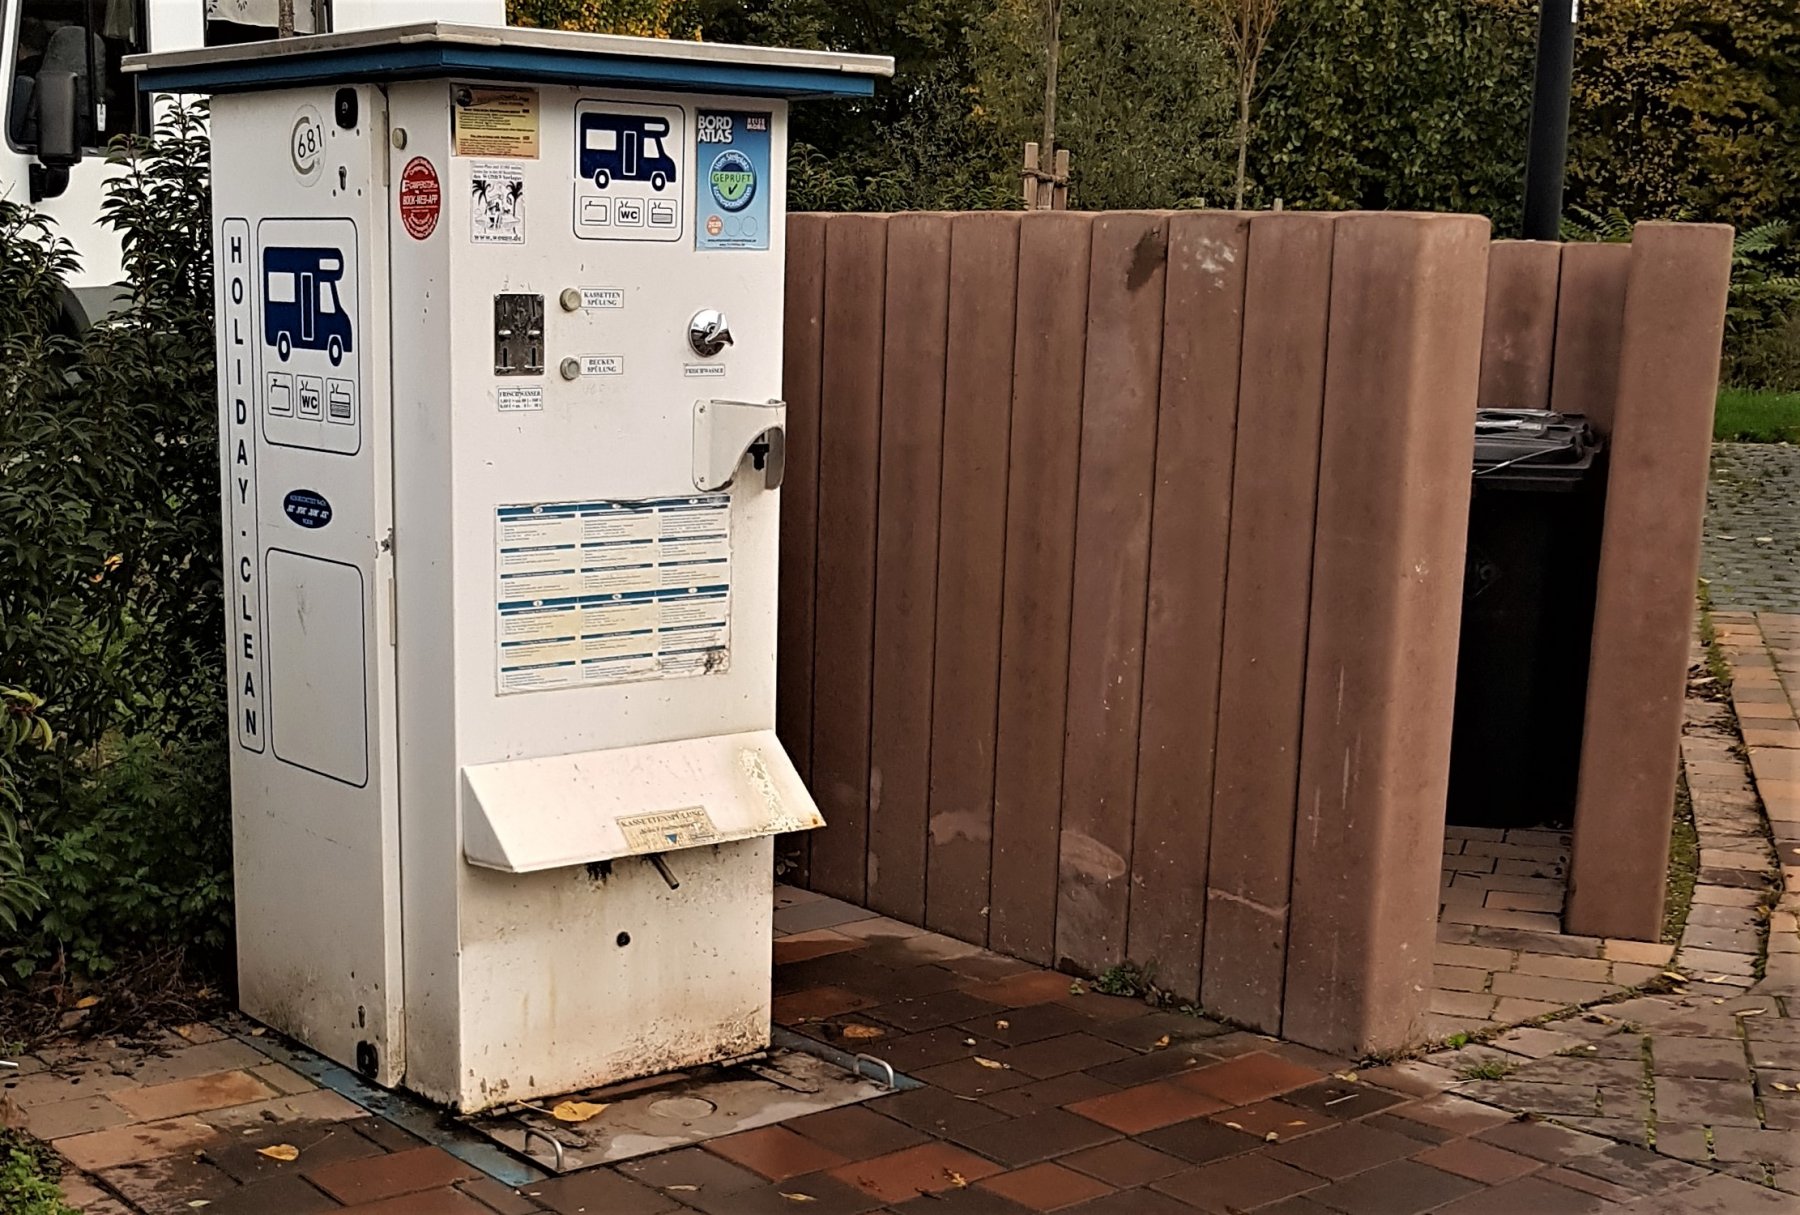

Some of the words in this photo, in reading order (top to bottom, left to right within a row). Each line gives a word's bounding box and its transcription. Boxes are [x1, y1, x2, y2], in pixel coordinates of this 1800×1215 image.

[698, 115, 732, 129] BORD
[297, 124, 322, 158] 681
[698, 129, 732, 143] ATLAS
[713, 172, 751, 182] GEPRÜFT
[621, 211, 638, 220] WC
[583, 291, 621, 299] KASSETTEN
[301, 395, 318, 409] WC
